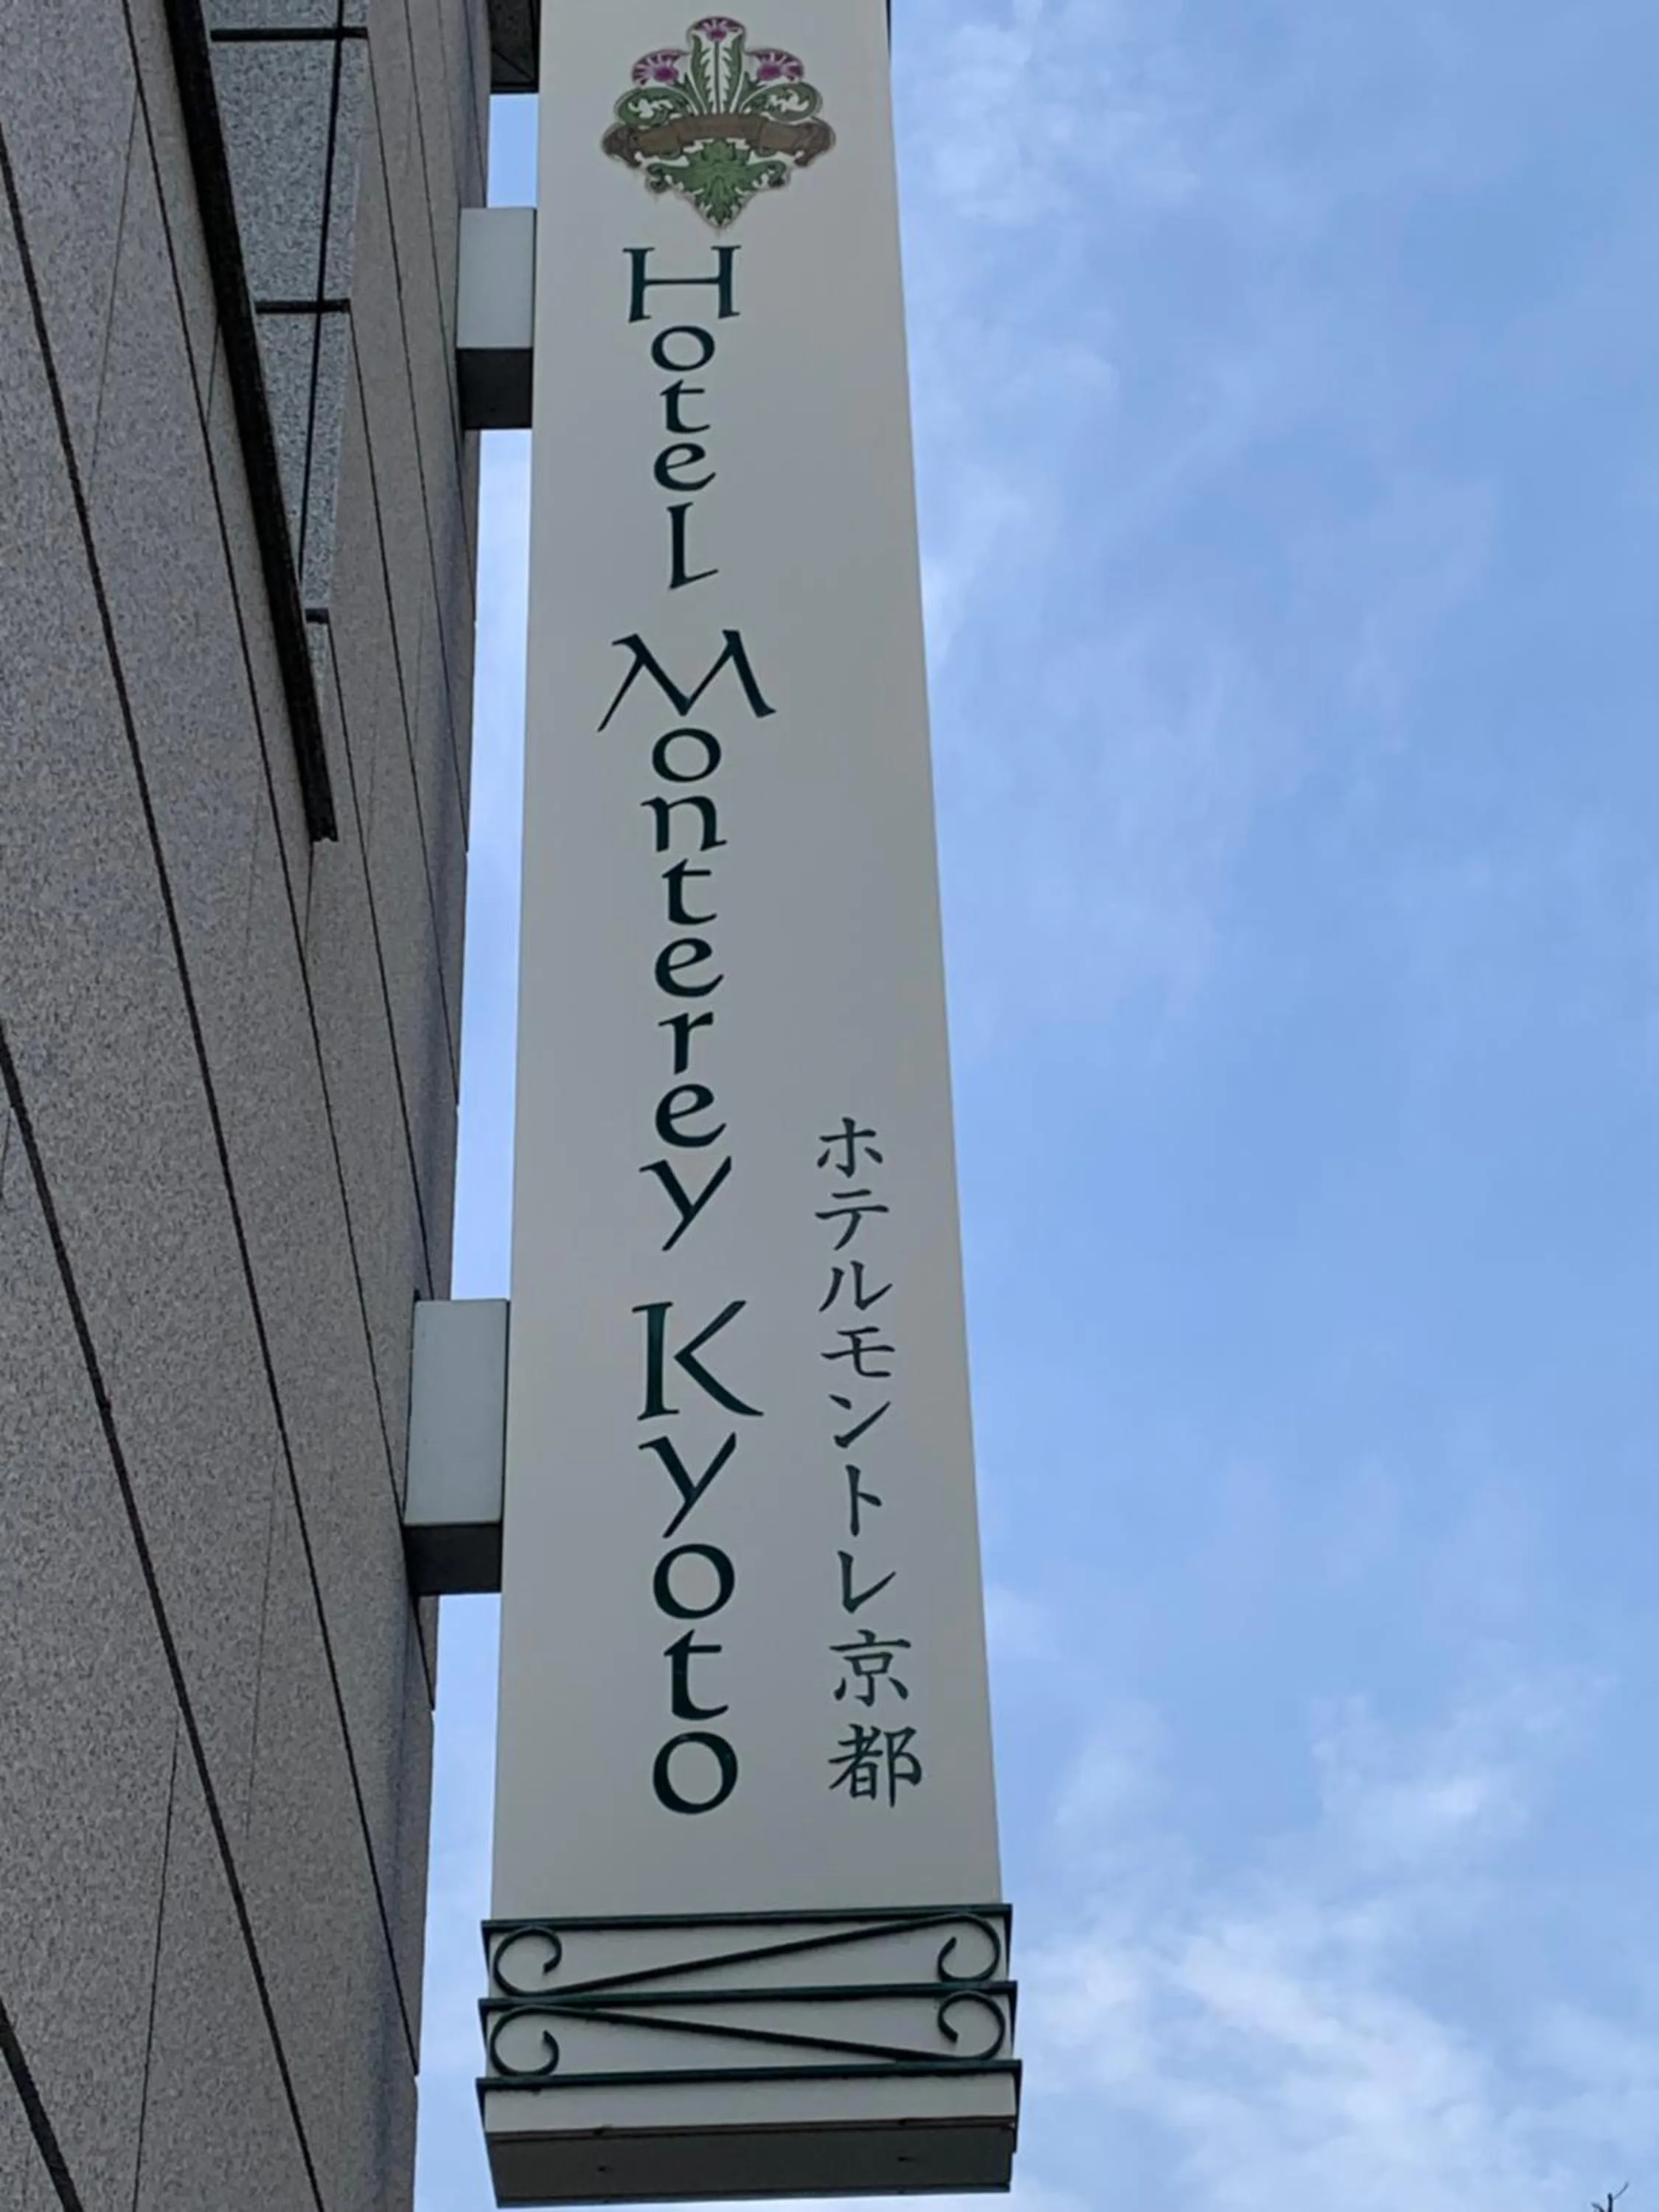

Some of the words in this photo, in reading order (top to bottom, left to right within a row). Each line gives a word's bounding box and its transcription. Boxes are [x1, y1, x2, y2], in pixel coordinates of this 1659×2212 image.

[597, 629, 777, 1253] Monterey
[631, 1300, 765, 1816] Kyoto
[814, 1116, 923, 1809] ホテルモントレ京都
